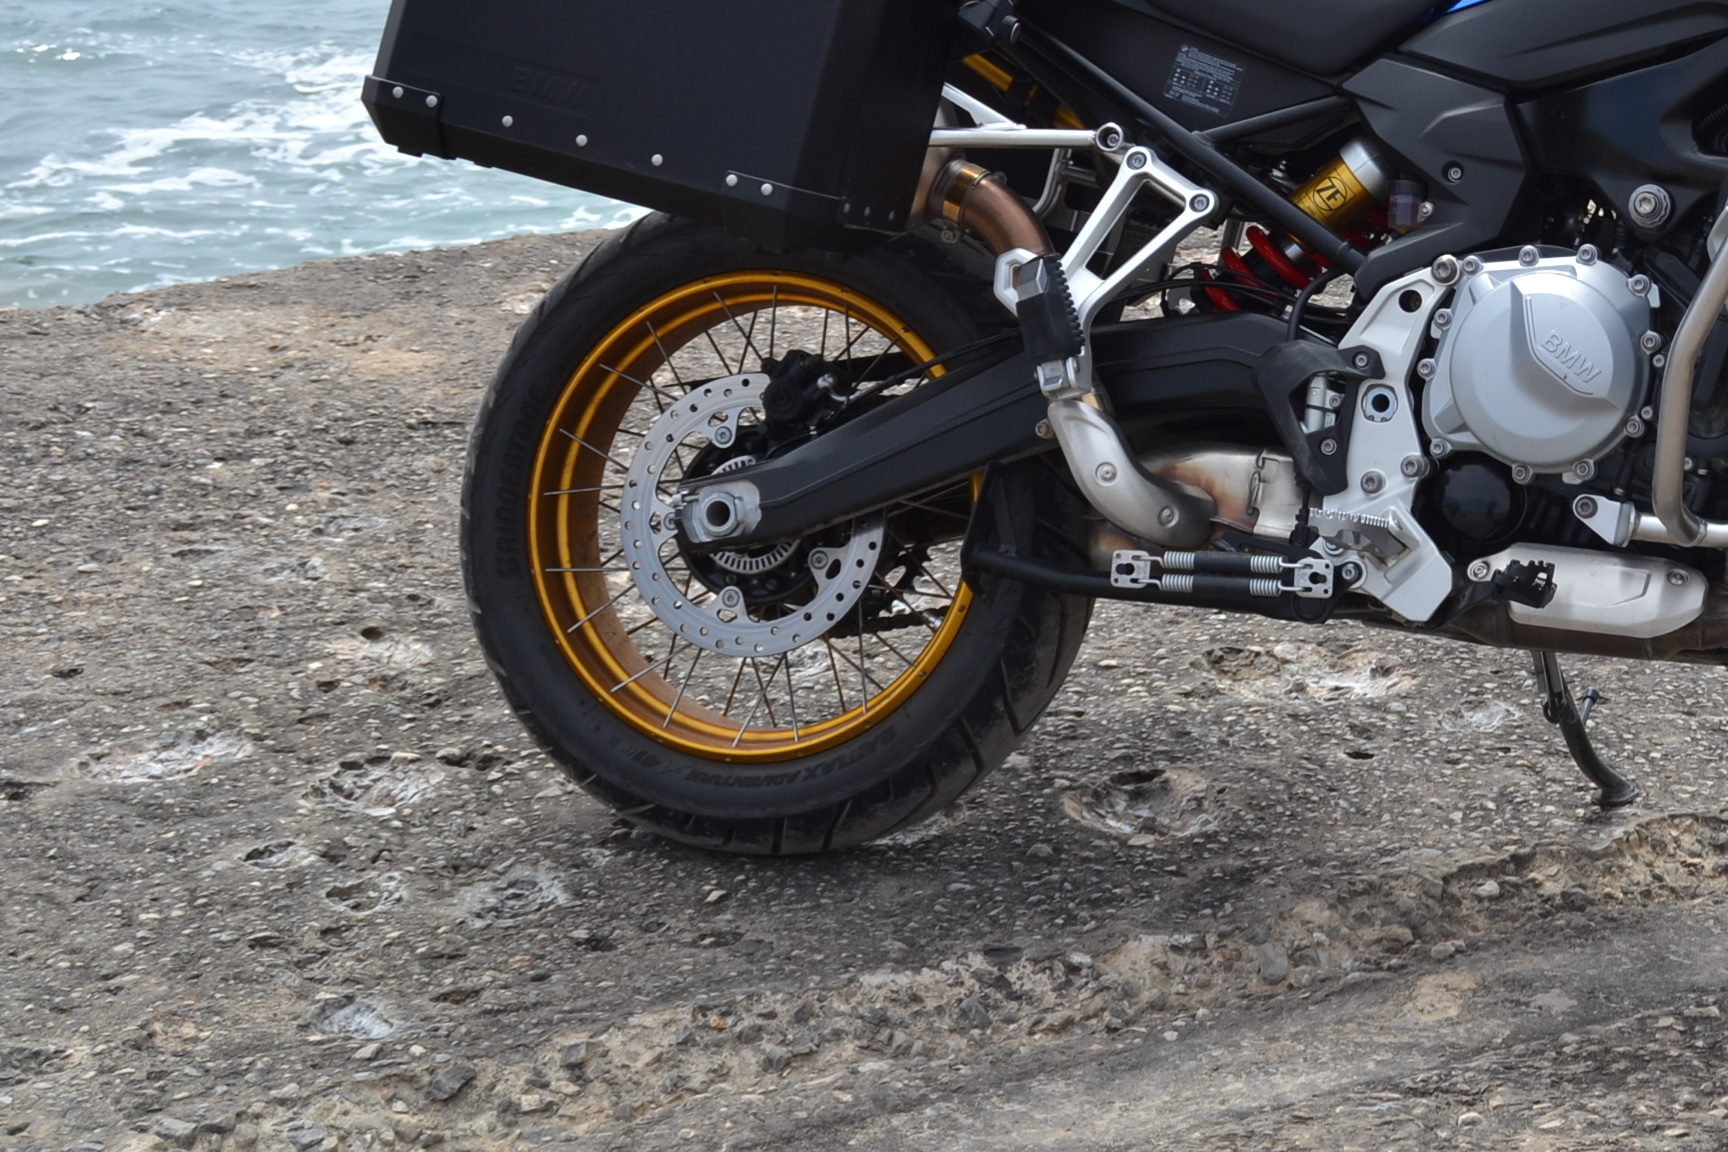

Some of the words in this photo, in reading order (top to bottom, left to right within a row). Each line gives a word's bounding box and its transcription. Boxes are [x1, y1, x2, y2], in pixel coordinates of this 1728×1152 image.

[511, 65, 591, 108] BMW
[1314, 176, 1347, 211] ZF
[1541, 330, 1602, 384] BMW
